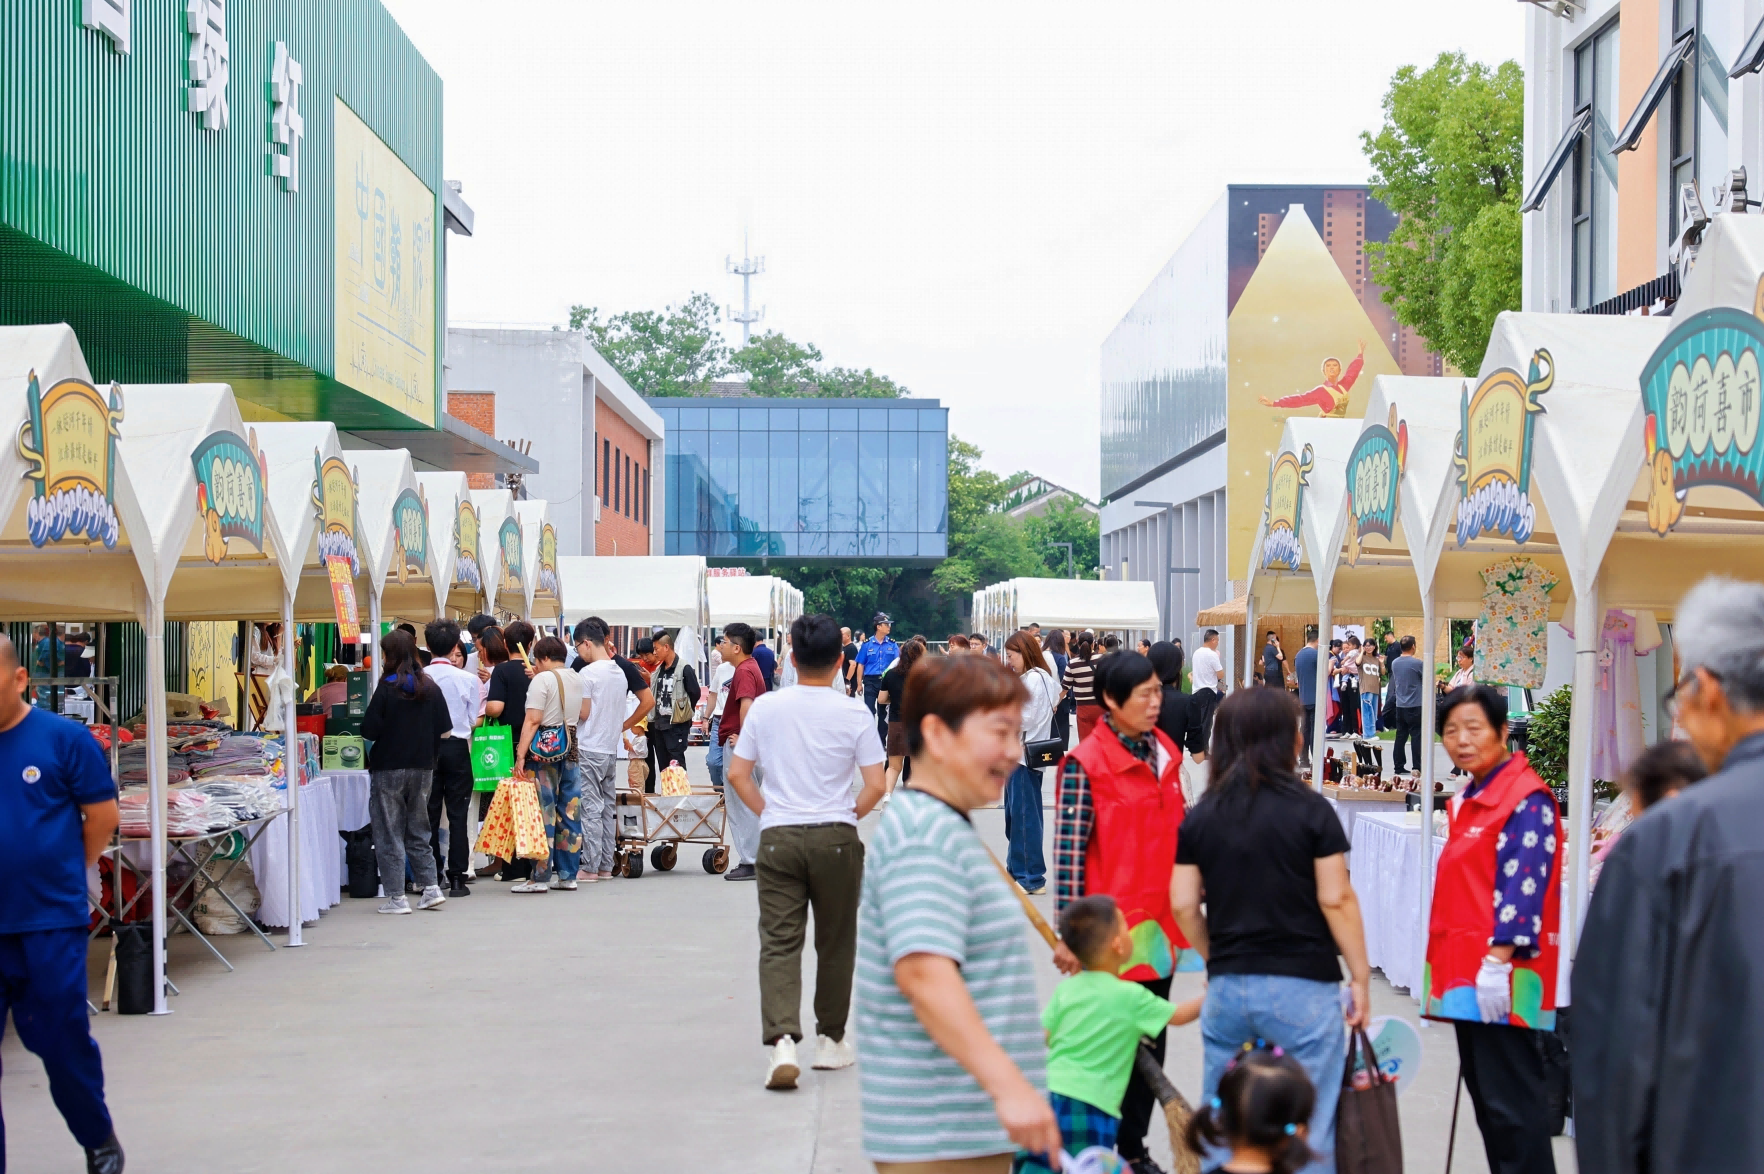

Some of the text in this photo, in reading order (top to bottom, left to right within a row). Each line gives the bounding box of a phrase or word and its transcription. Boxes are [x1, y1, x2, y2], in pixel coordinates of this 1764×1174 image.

[1669, 370, 1756, 436] 韵荷喜市
[212, 469, 254, 514] 韵荷喜市
[1356, 461, 1389, 505] 韵荷喜市
